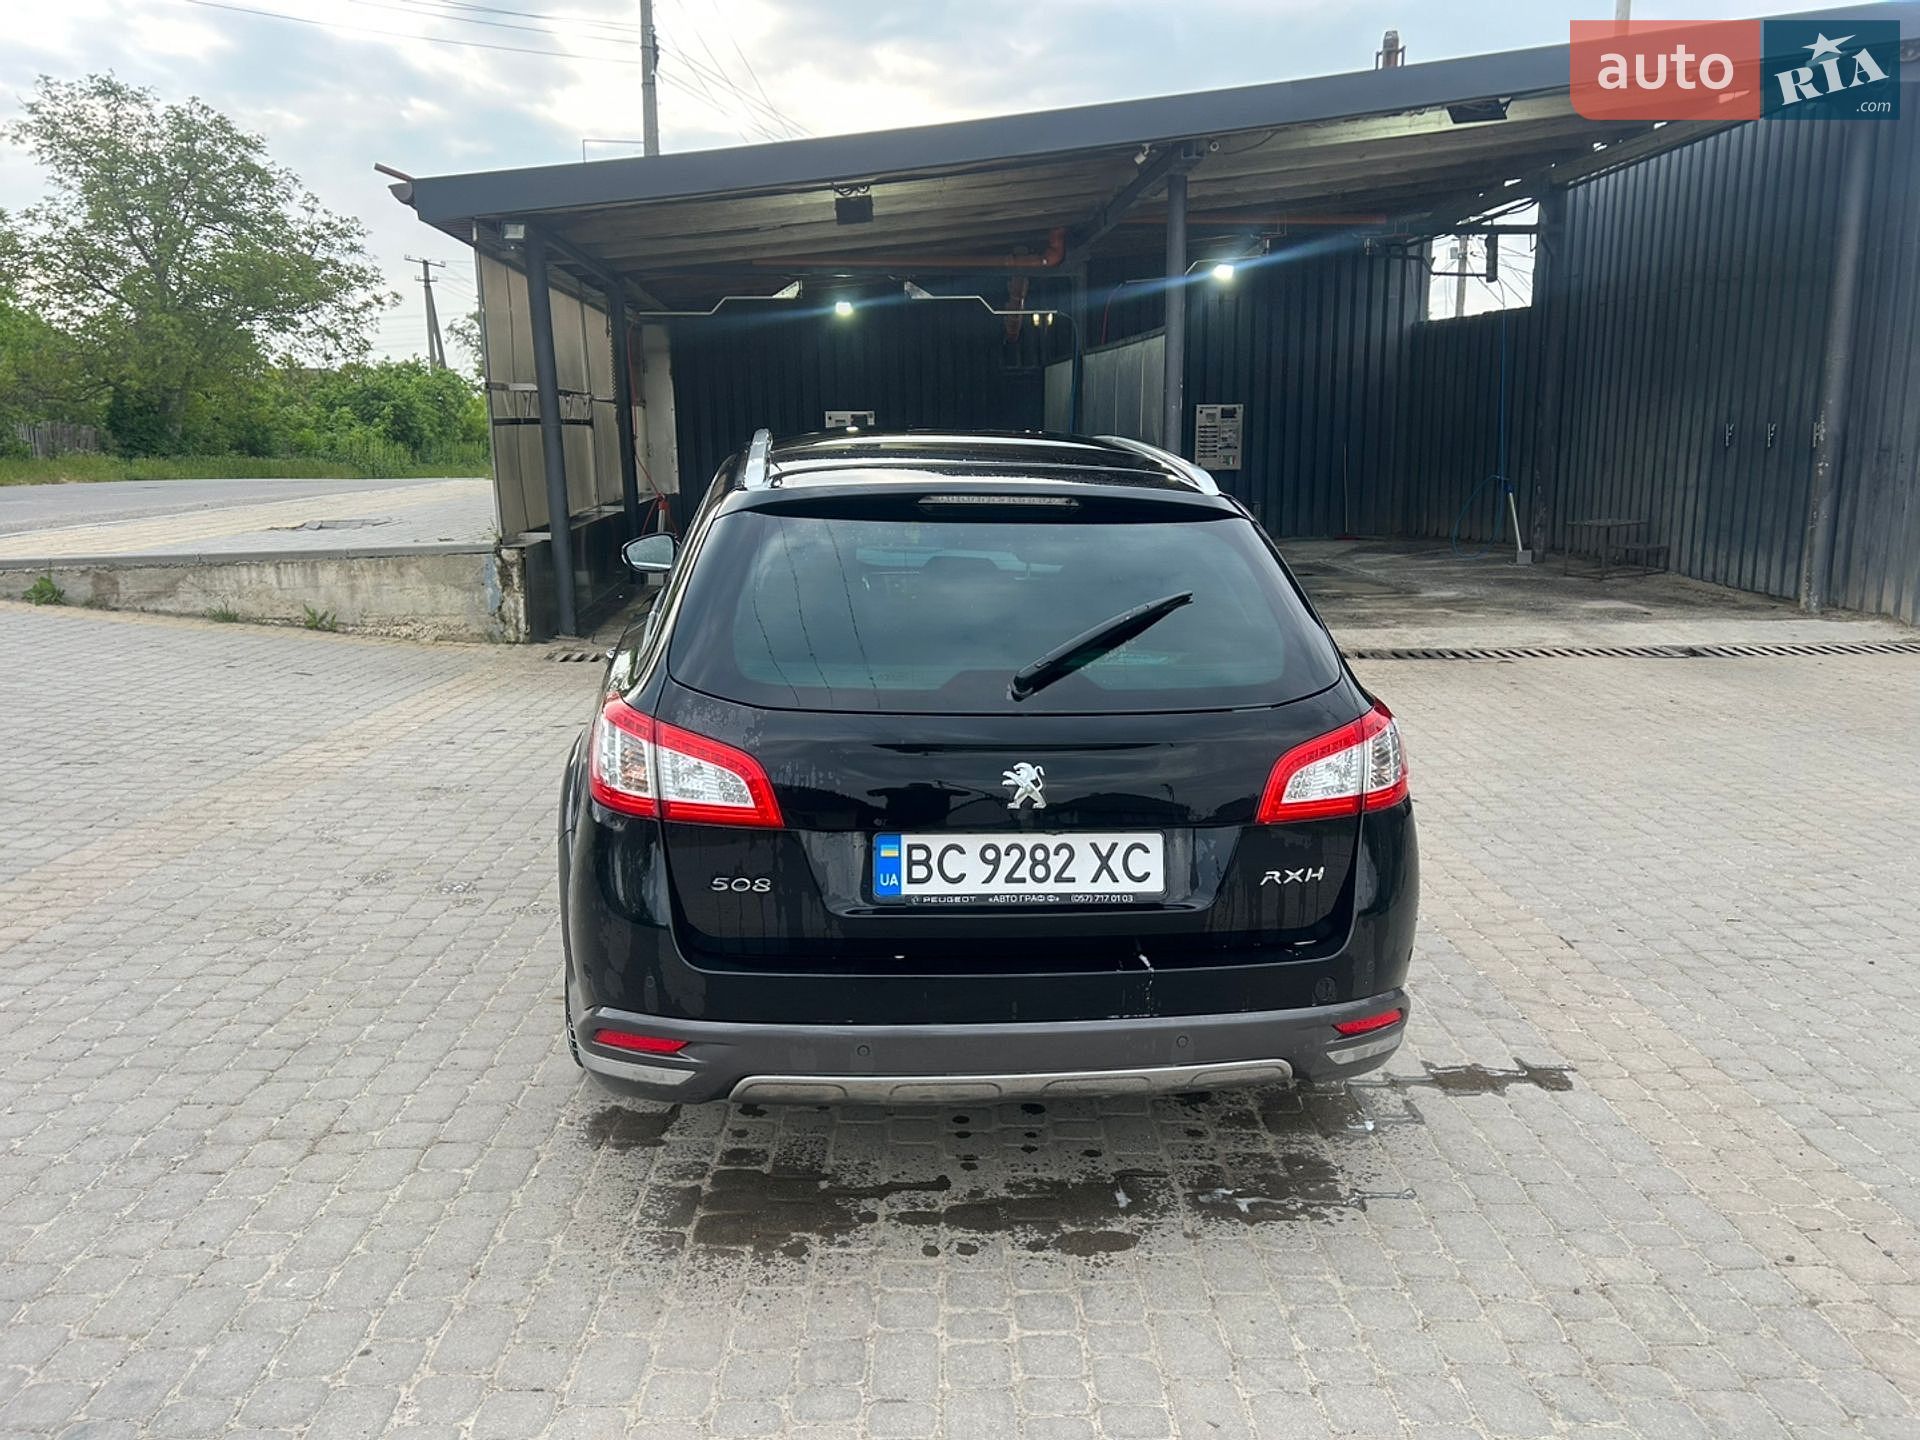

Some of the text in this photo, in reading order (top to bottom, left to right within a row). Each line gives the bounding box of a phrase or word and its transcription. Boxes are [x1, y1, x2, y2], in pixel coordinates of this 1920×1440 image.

[906, 842, 1151, 885] BC 9282 XC
[710, 877, 771, 892] 508
[880, 874, 899, 886] UA
[1260, 866, 1325, 886] RXH
